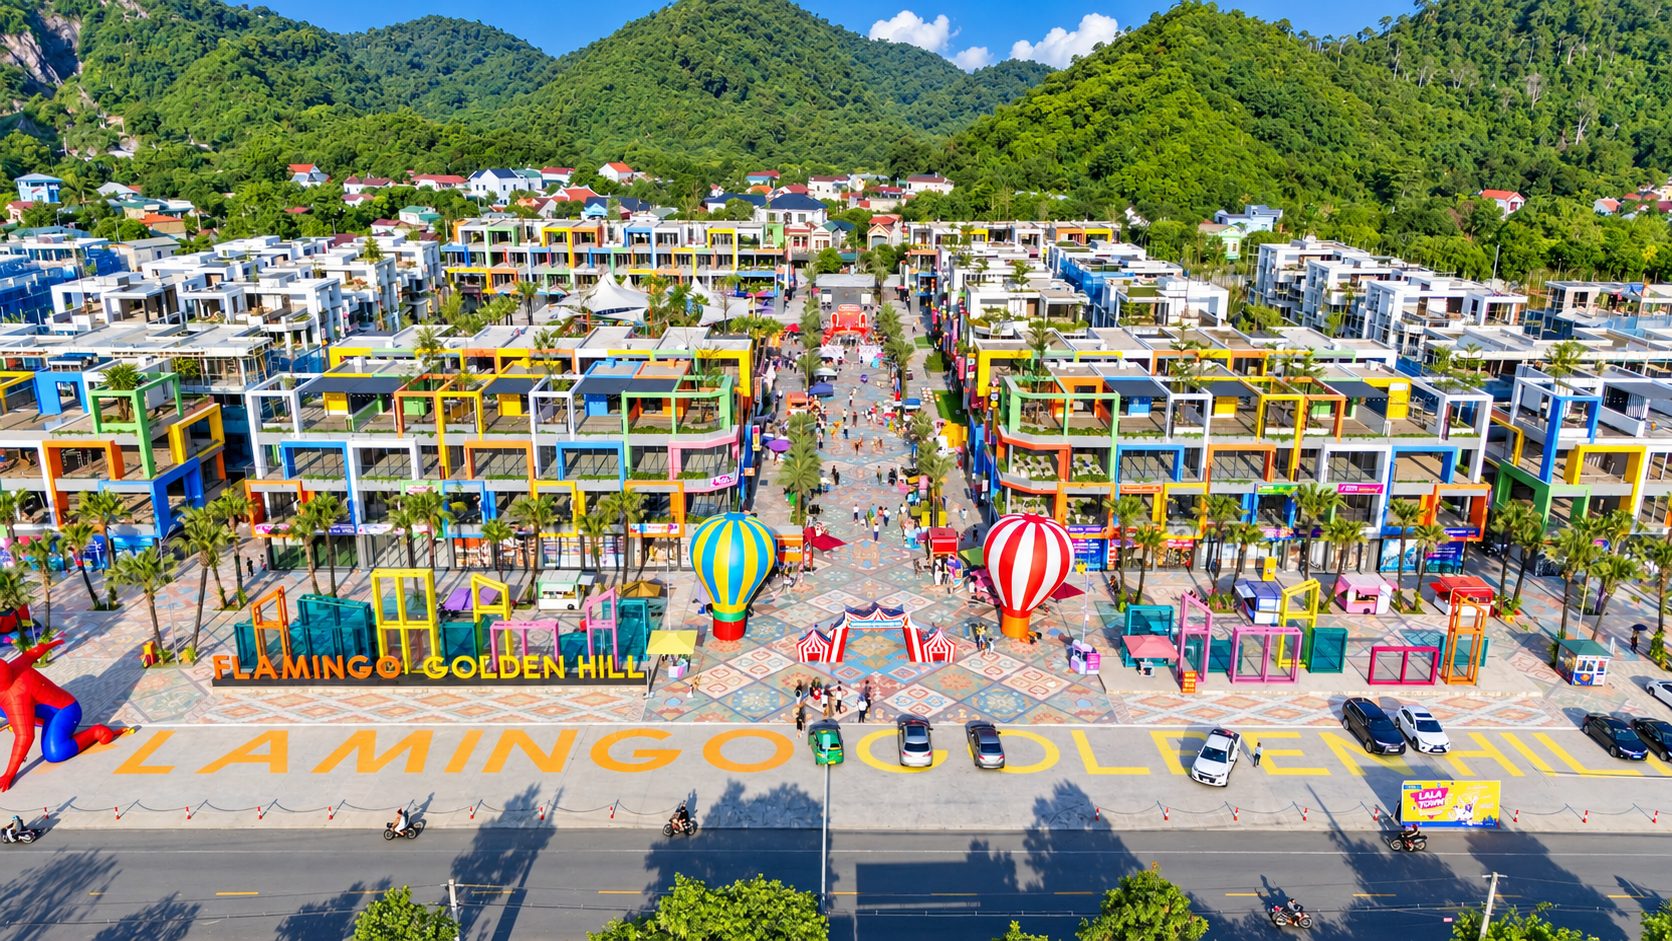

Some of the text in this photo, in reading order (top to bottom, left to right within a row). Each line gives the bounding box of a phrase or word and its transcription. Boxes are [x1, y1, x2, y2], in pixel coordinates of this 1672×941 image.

[213, 655, 645, 681] FLAMINGO GOLDEN HILL
[33, 728, 795, 774] LAMINGO
[1418, 790, 1442, 800] LALA
